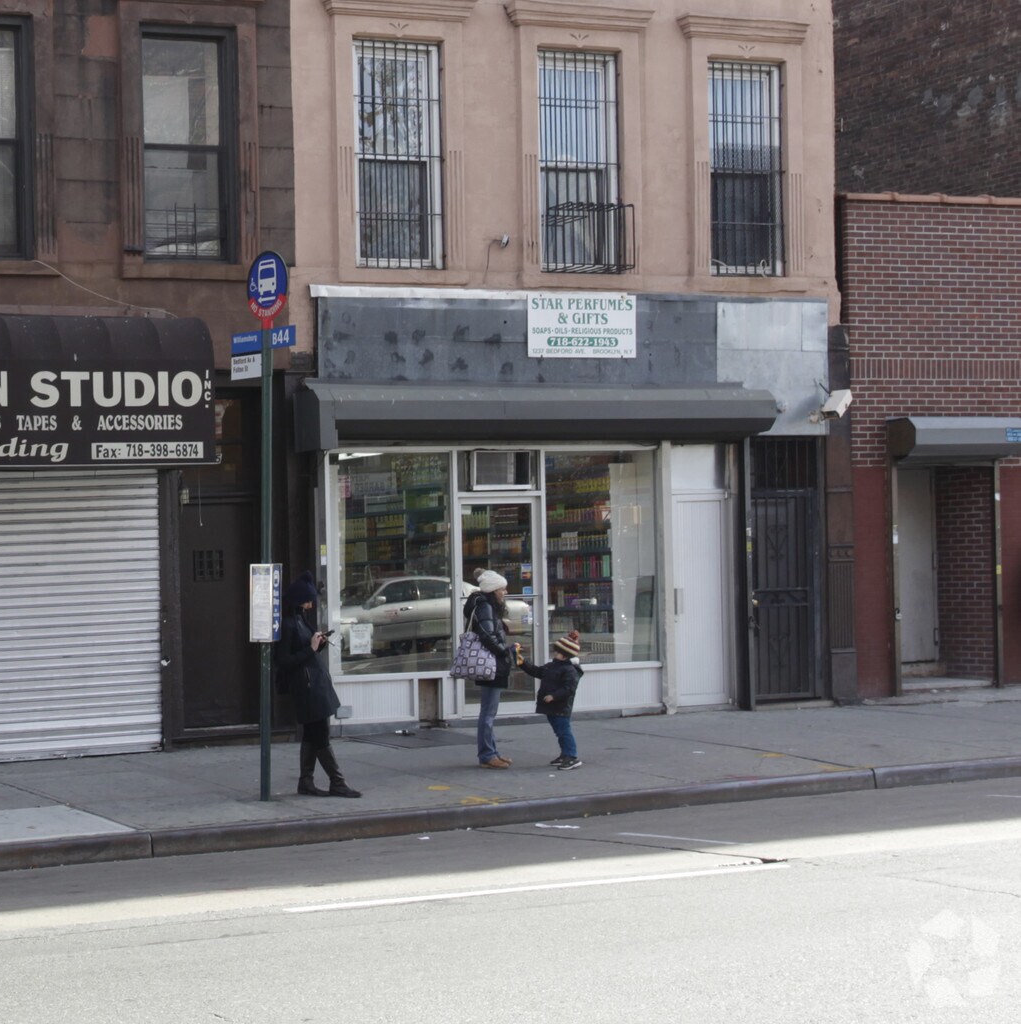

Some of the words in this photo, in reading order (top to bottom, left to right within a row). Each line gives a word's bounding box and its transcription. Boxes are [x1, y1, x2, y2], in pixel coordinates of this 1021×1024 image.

[531, 298, 563, 310] STAR
[568, 298, 633, 311] PERFUMES
[558, 312, 568, 324] &
[572, 313, 608, 325] GIFTS
[272, 328, 289, 345] B44
[571, 327, 601, 335] RELIGIOUS
[549, 337, 616, 346] 718-622-1943
[30, 370, 203, 408] STUDIO
[204, 369, 212, 409] INC.
[17, 415, 57, 430] TAPES
[72, 416, 82, 431] &
[97, 415, 183, 430] ACCESSORIES
[96, 444, 121, 458] Fax:
[127, 443, 198, 457] 718-398-6874
